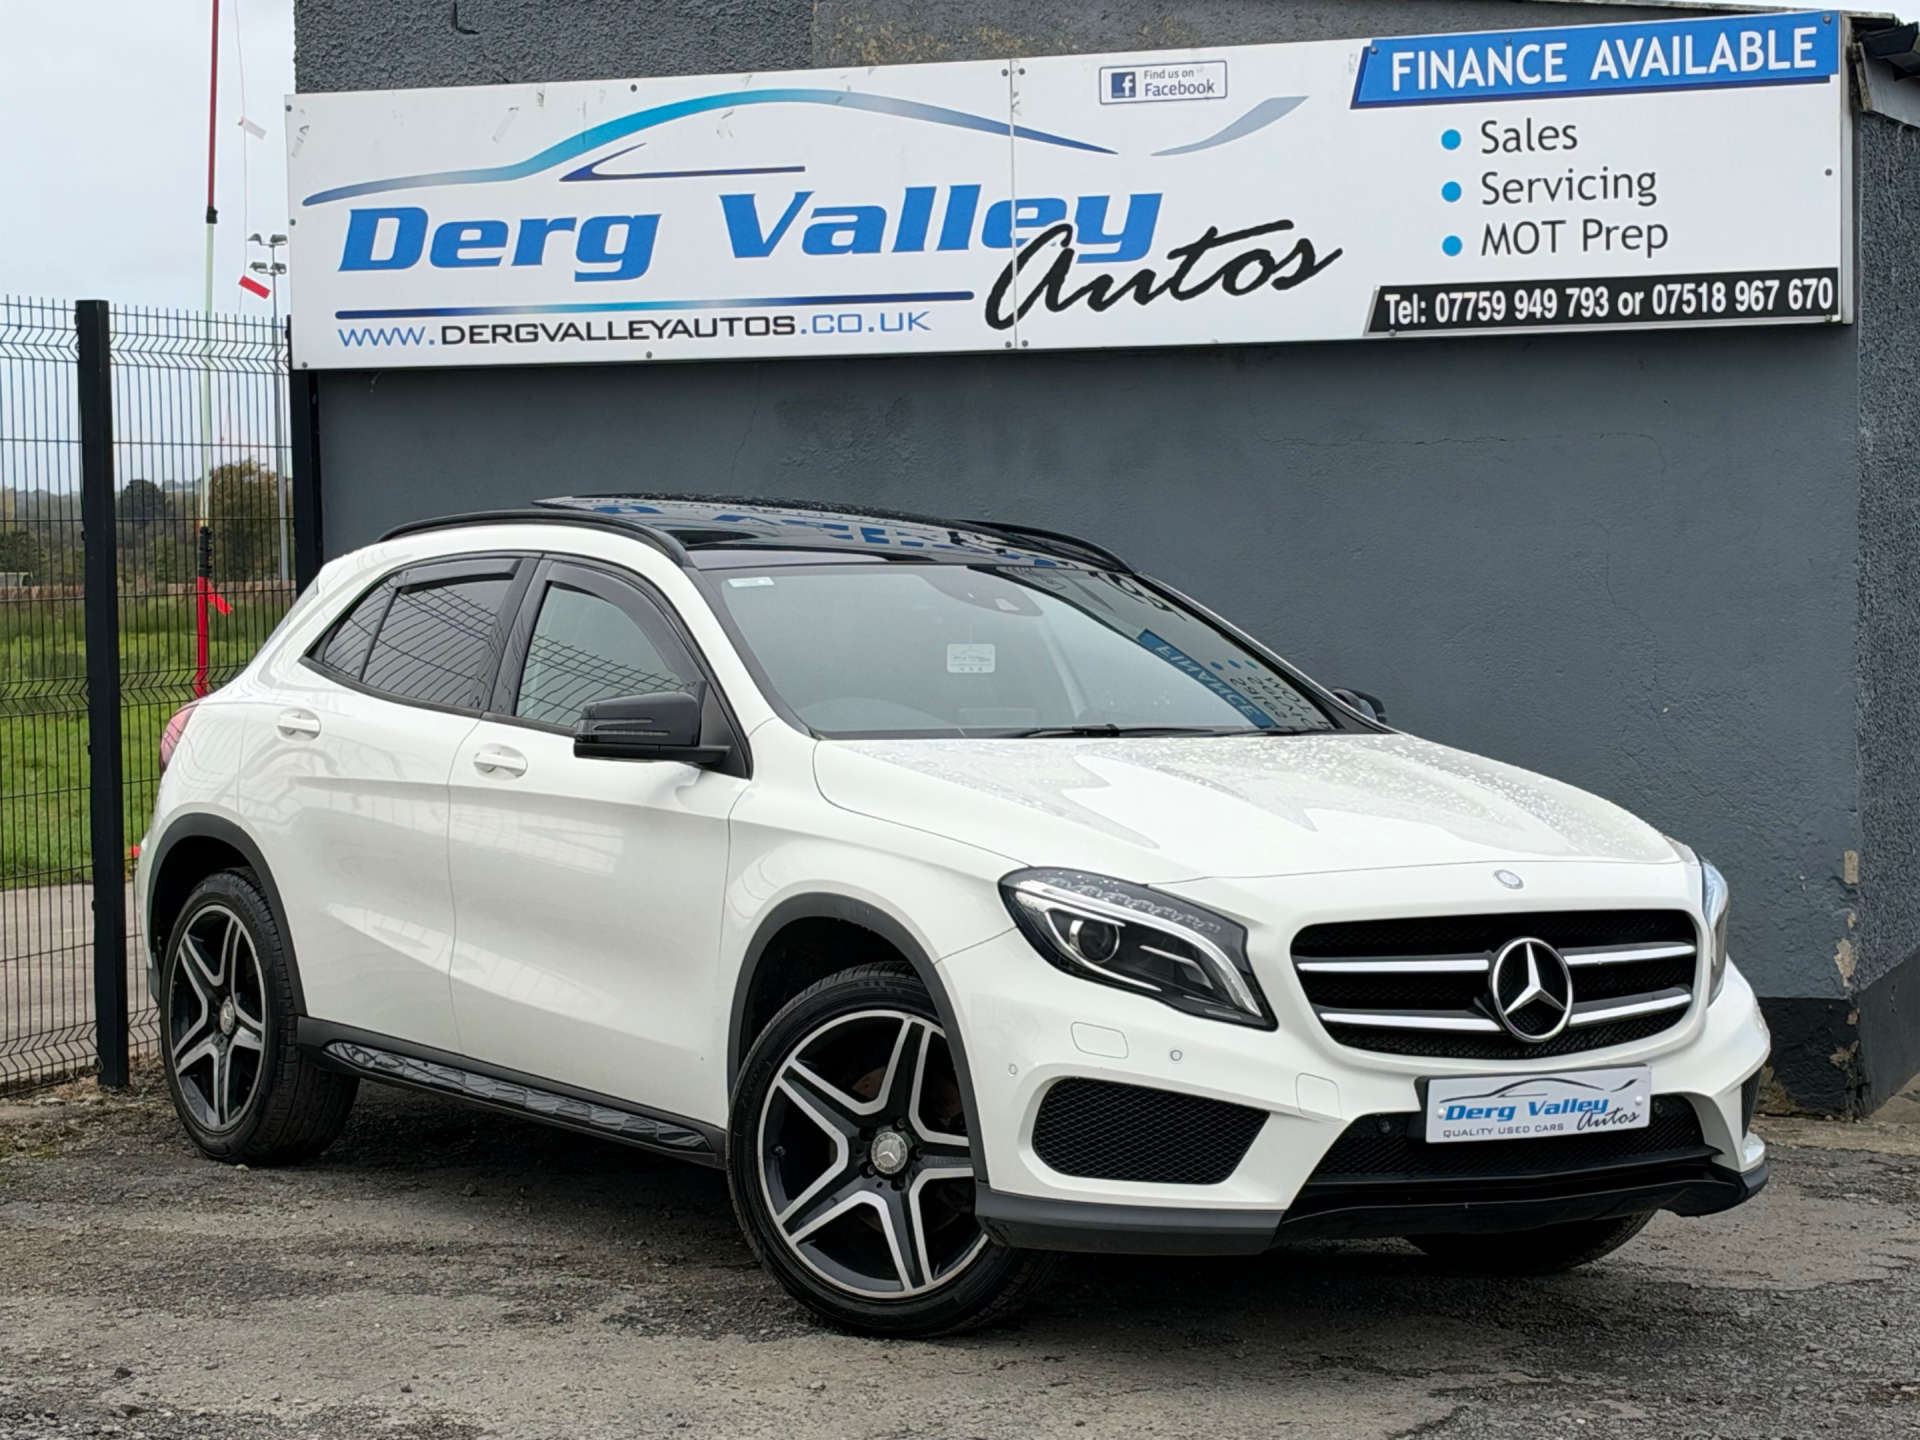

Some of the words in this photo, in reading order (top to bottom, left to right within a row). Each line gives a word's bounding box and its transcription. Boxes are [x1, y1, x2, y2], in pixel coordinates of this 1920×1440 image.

[1143, 69, 1166, 80] Find
[1168, 71, 1180, 79] us
[1181, 69, 1195, 78] on
[1392, 42, 1568, 92] FINANCE
[1590, 27, 1817, 81] AVAILABLE
[1144, 79, 1216, 97] Facebook
[1481, 118, 1578, 154] Sales
[1481, 166, 1658, 206] Servicing
[337, 206, 663, 283] Derg
[719, 184, 1163, 265] Valley
[1481, 219, 1567, 257] MOT
[1583, 218, 1669, 258] Prep
[983, 218, 1343, 331] Autos
[1384, 293, 1427, 326] Tel:
[1434, 290, 1507, 324] 07759
[1513, 287, 1558, 321] 949
[1565, 285, 1610, 319] 793
[1617, 290, 1645, 317] or
[1652, 281, 1727, 316] 07518
[1734, 279, 1780, 313] 967
[1788, 276, 1834, 311] 670
[1443, 1104, 1517, 1123] Derg
[1528, 1098, 1610, 1117] Valley
[1576, 1107, 1641, 1132] Autos
[1442, 1127, 1495, 1138] QUALITY
[1497, 1125, 1531, 1135] USED
[1534, 1123, 1565, 1133] CARS
